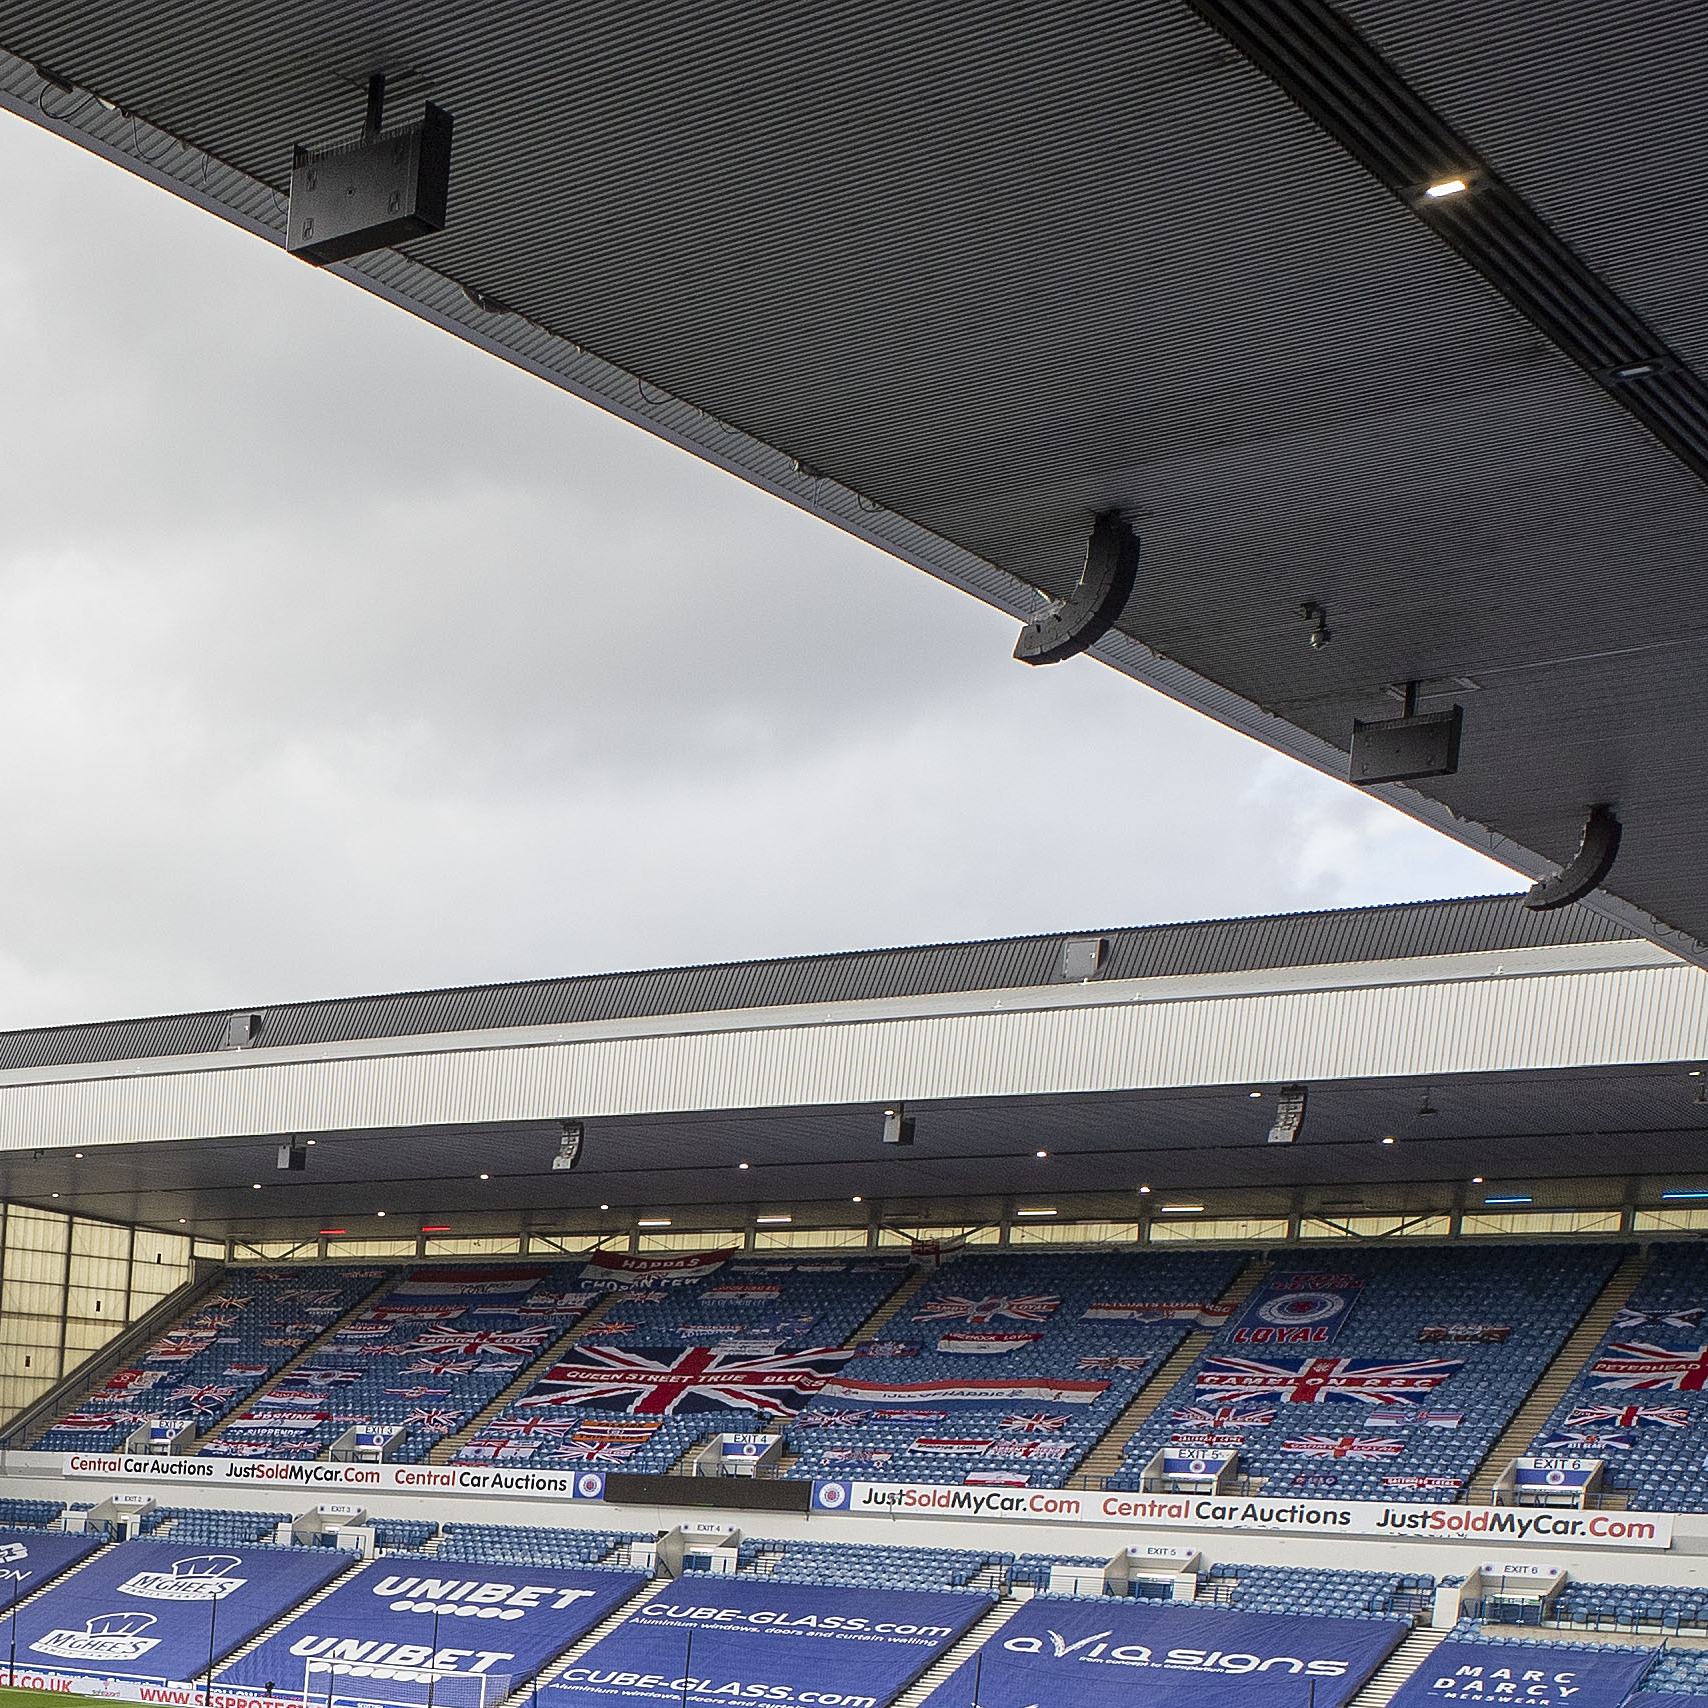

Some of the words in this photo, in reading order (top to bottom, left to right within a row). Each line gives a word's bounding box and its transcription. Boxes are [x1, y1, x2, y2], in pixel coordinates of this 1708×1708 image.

[1233, 1327, 1330, 1343] LOYAL
[1595, 1362, 1700, 1371] PETERHEAD
[567, 1371, 623, 1380] QUEEN
[625, 1373, 693, 1383] STREET
[698, 1373, 747, 1383] TRUE
[763, 1375, 827, 1388] BLUES
[1205, 1376, 1348, 1388] CAMELON
[159, 1420, 177, 1428] EXIT
[178, 1421, 185, 1429] 2
[365, 1426, 385, 1434] EXIT
[386, 1427, 393, 1435] 3
[734, 1435, 758, 1444] EXIT
[760, 1436, 768, 1444] 4
[1177, 1448, 1209, 1459] EXIT
[1210, 1450, 1219, 1460] 5
[1534, 1459, 1569, 1469] EXIT
[1572, 1460, 1581, 1470] 6
[70, 1456, 122, 1473] Central
[124, 1459, 149, 1473] Car
[151, 1460, 213, 1477] Auctions
[225, 1462, 380, 1484] JustSoldMyCar.Com
[395, 1469, 456, 1487] Central
[459, 1472, 489, 1487] Car
[492, 1473, 567, 1492] Auctions
[861, 1487, 1081, 1516] JustSoldMyCar.Com
[1102, 1496, 1191, 1521] Central
[1195, 1500, 1238, 1521] Car
[1241, 1501, 1351, 1527] Auctions
[1376, 1507, 1655, 1541] JustSoldMyCar.Com
[1147, 1547, 1170, 1556] EXIT
[1503, 1565, 1530, 1574] EXIT
[372, 1576, 596, 1609] UNIBET
[641, 1604, 953, 1638] CUBE-GLASS.com
[629, 1616, 698, 1629] Aluminium
[764, 1626, 803, 1637] doors
[806, 1630, 834, 1639] and
[835, 1631, 884, 1643] curtain
[886, 1635, 939, 1648] walling
[289, 1635, 515, 1672] UNIBET
[1166, 1646, 1350, 1678] signs
[1455, 1665, 1577, 1684] MARC
[549, 1682, 619, 1700] Aluminium
[686, 1695, 724, 1706] doors
[727, 1700, 755, 1708] and
[1433, 1677, 1581, 1698] DARCY
[1444, 1691, 1551, 1706] MENSWEAR
